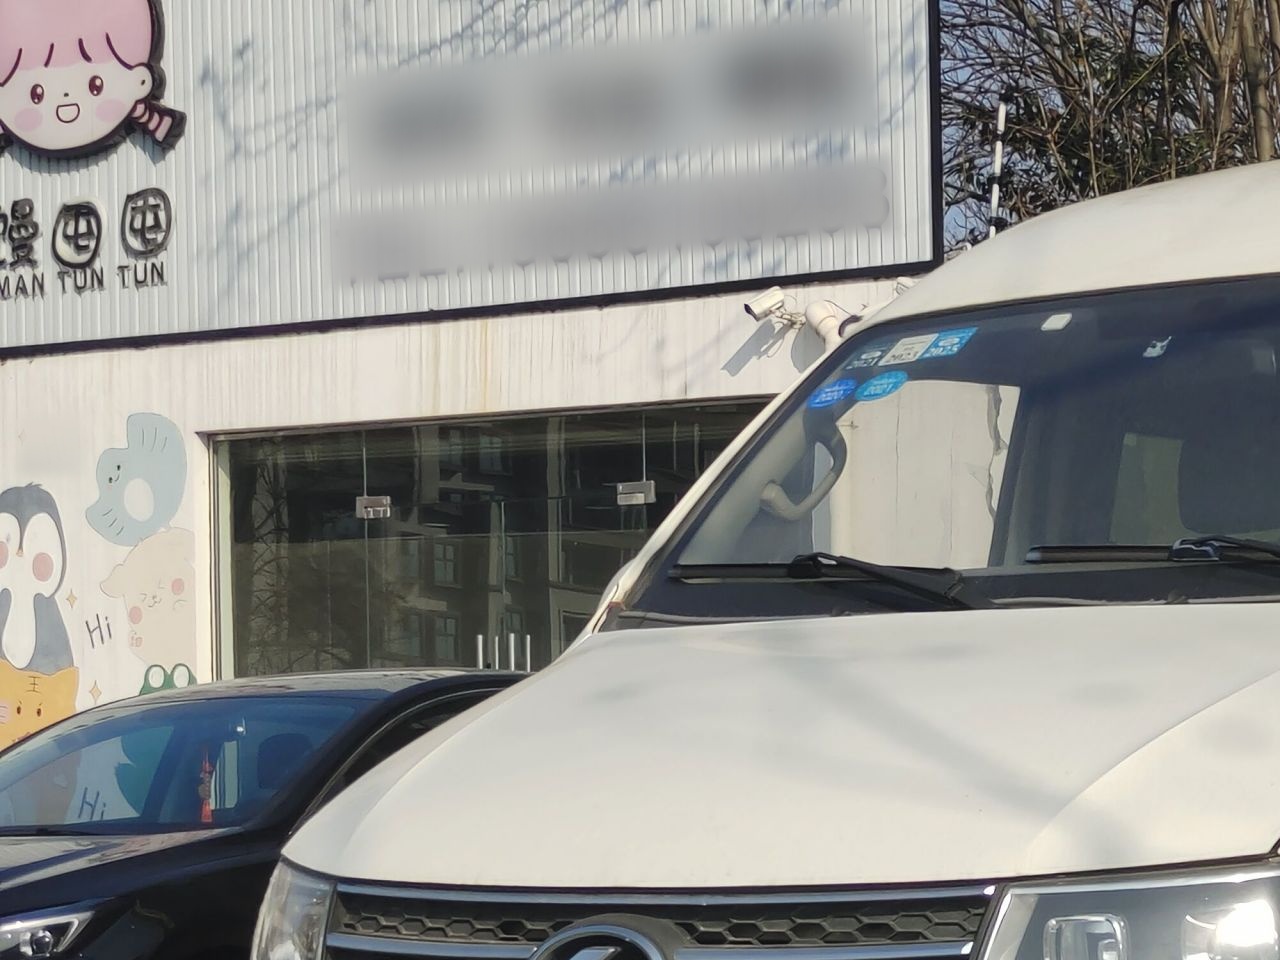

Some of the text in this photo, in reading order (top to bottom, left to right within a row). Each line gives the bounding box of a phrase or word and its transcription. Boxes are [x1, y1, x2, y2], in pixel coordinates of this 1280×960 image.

[0, 261, 166, 299] MAN TUN TUN
[85, 613, 112, 648] Hi
